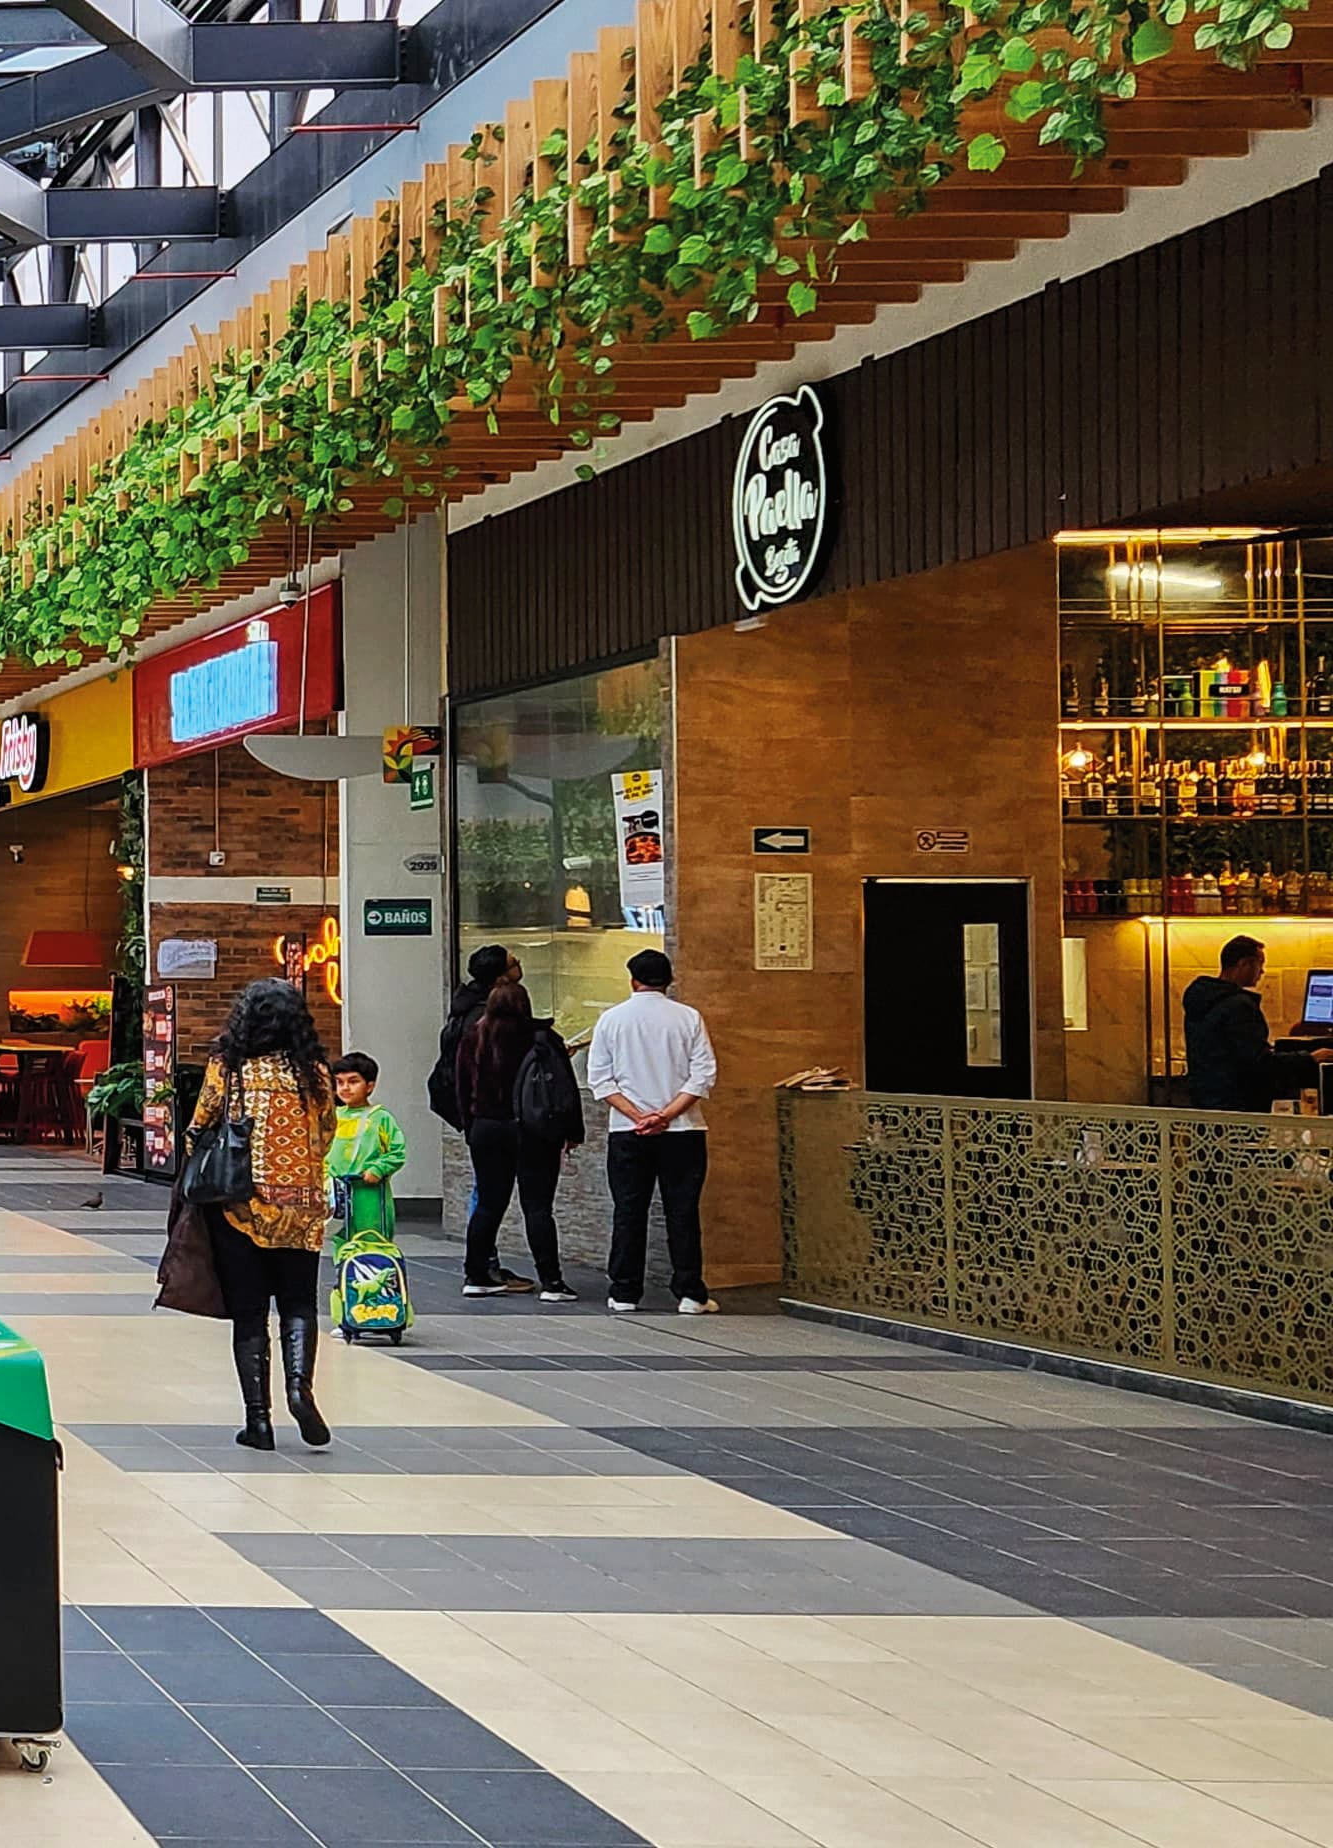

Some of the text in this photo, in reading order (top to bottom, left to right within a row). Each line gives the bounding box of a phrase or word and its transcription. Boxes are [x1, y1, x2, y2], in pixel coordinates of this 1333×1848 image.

[759, 425, 801, 471] Casa
[744, 468, 819, 541] Paella
[0, 714, 37, 791] Frisby
[408, 861, 438, 871] 2939
[384, 908, 427, 924] BAÑOS
